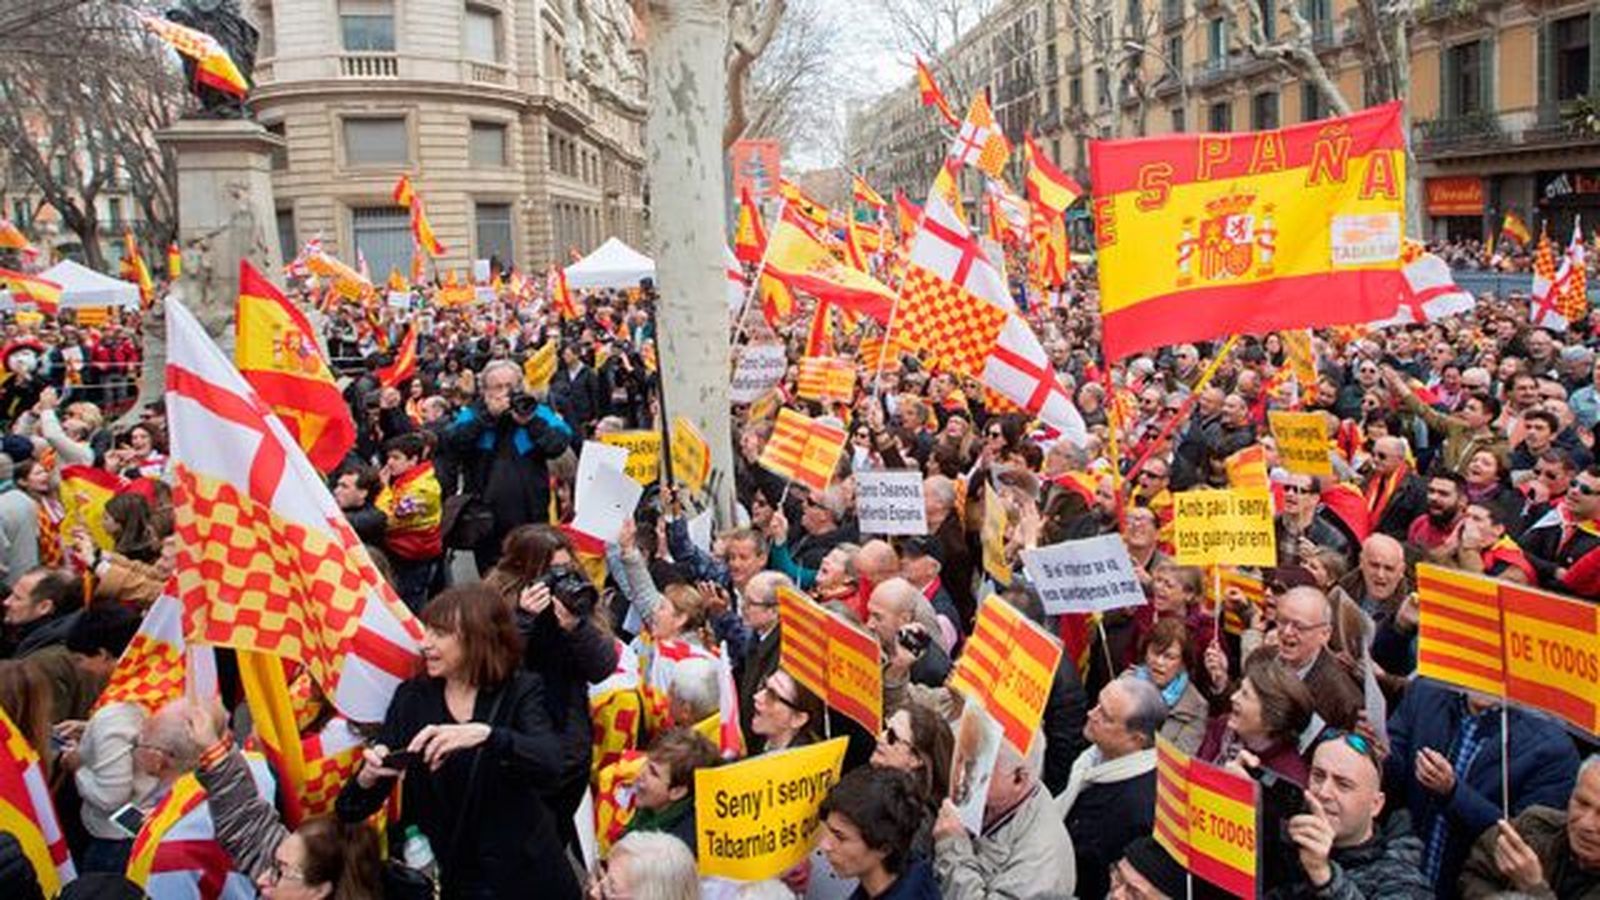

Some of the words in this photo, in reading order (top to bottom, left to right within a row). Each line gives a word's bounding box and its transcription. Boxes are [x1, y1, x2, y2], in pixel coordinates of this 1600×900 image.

[1511, 631, 1533, 663] DE
[1538, 639, 1598, 683] TODOS
[715, 789, 762, 820] Seny
[767, 779, 774, 808] i
[705, 825, 776, 859] Tabarnia
[1191, 805, 1206, 833] DE
[1209, 814, 1254, 852] TODOS
